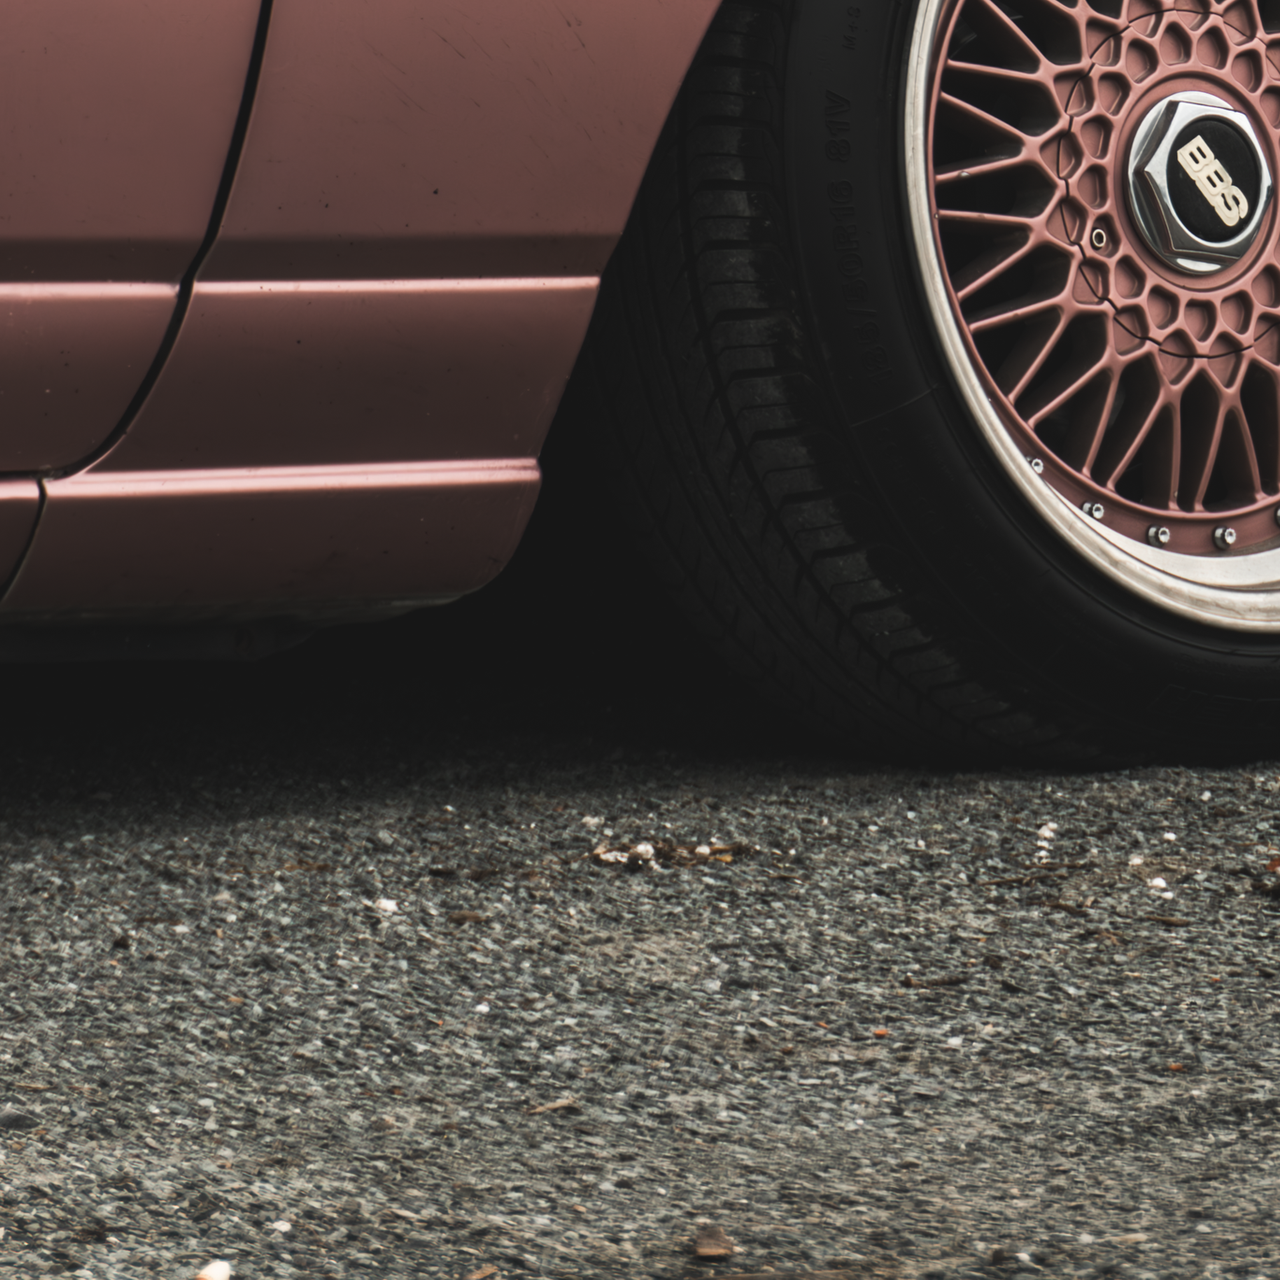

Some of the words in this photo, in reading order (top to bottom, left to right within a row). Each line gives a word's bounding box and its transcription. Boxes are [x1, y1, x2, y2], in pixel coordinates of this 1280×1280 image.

[824, 89, 852, 163] 81V
[1177, 134, 1249, 227] BBS
[826, 179, 894, 387] 185/50R16
